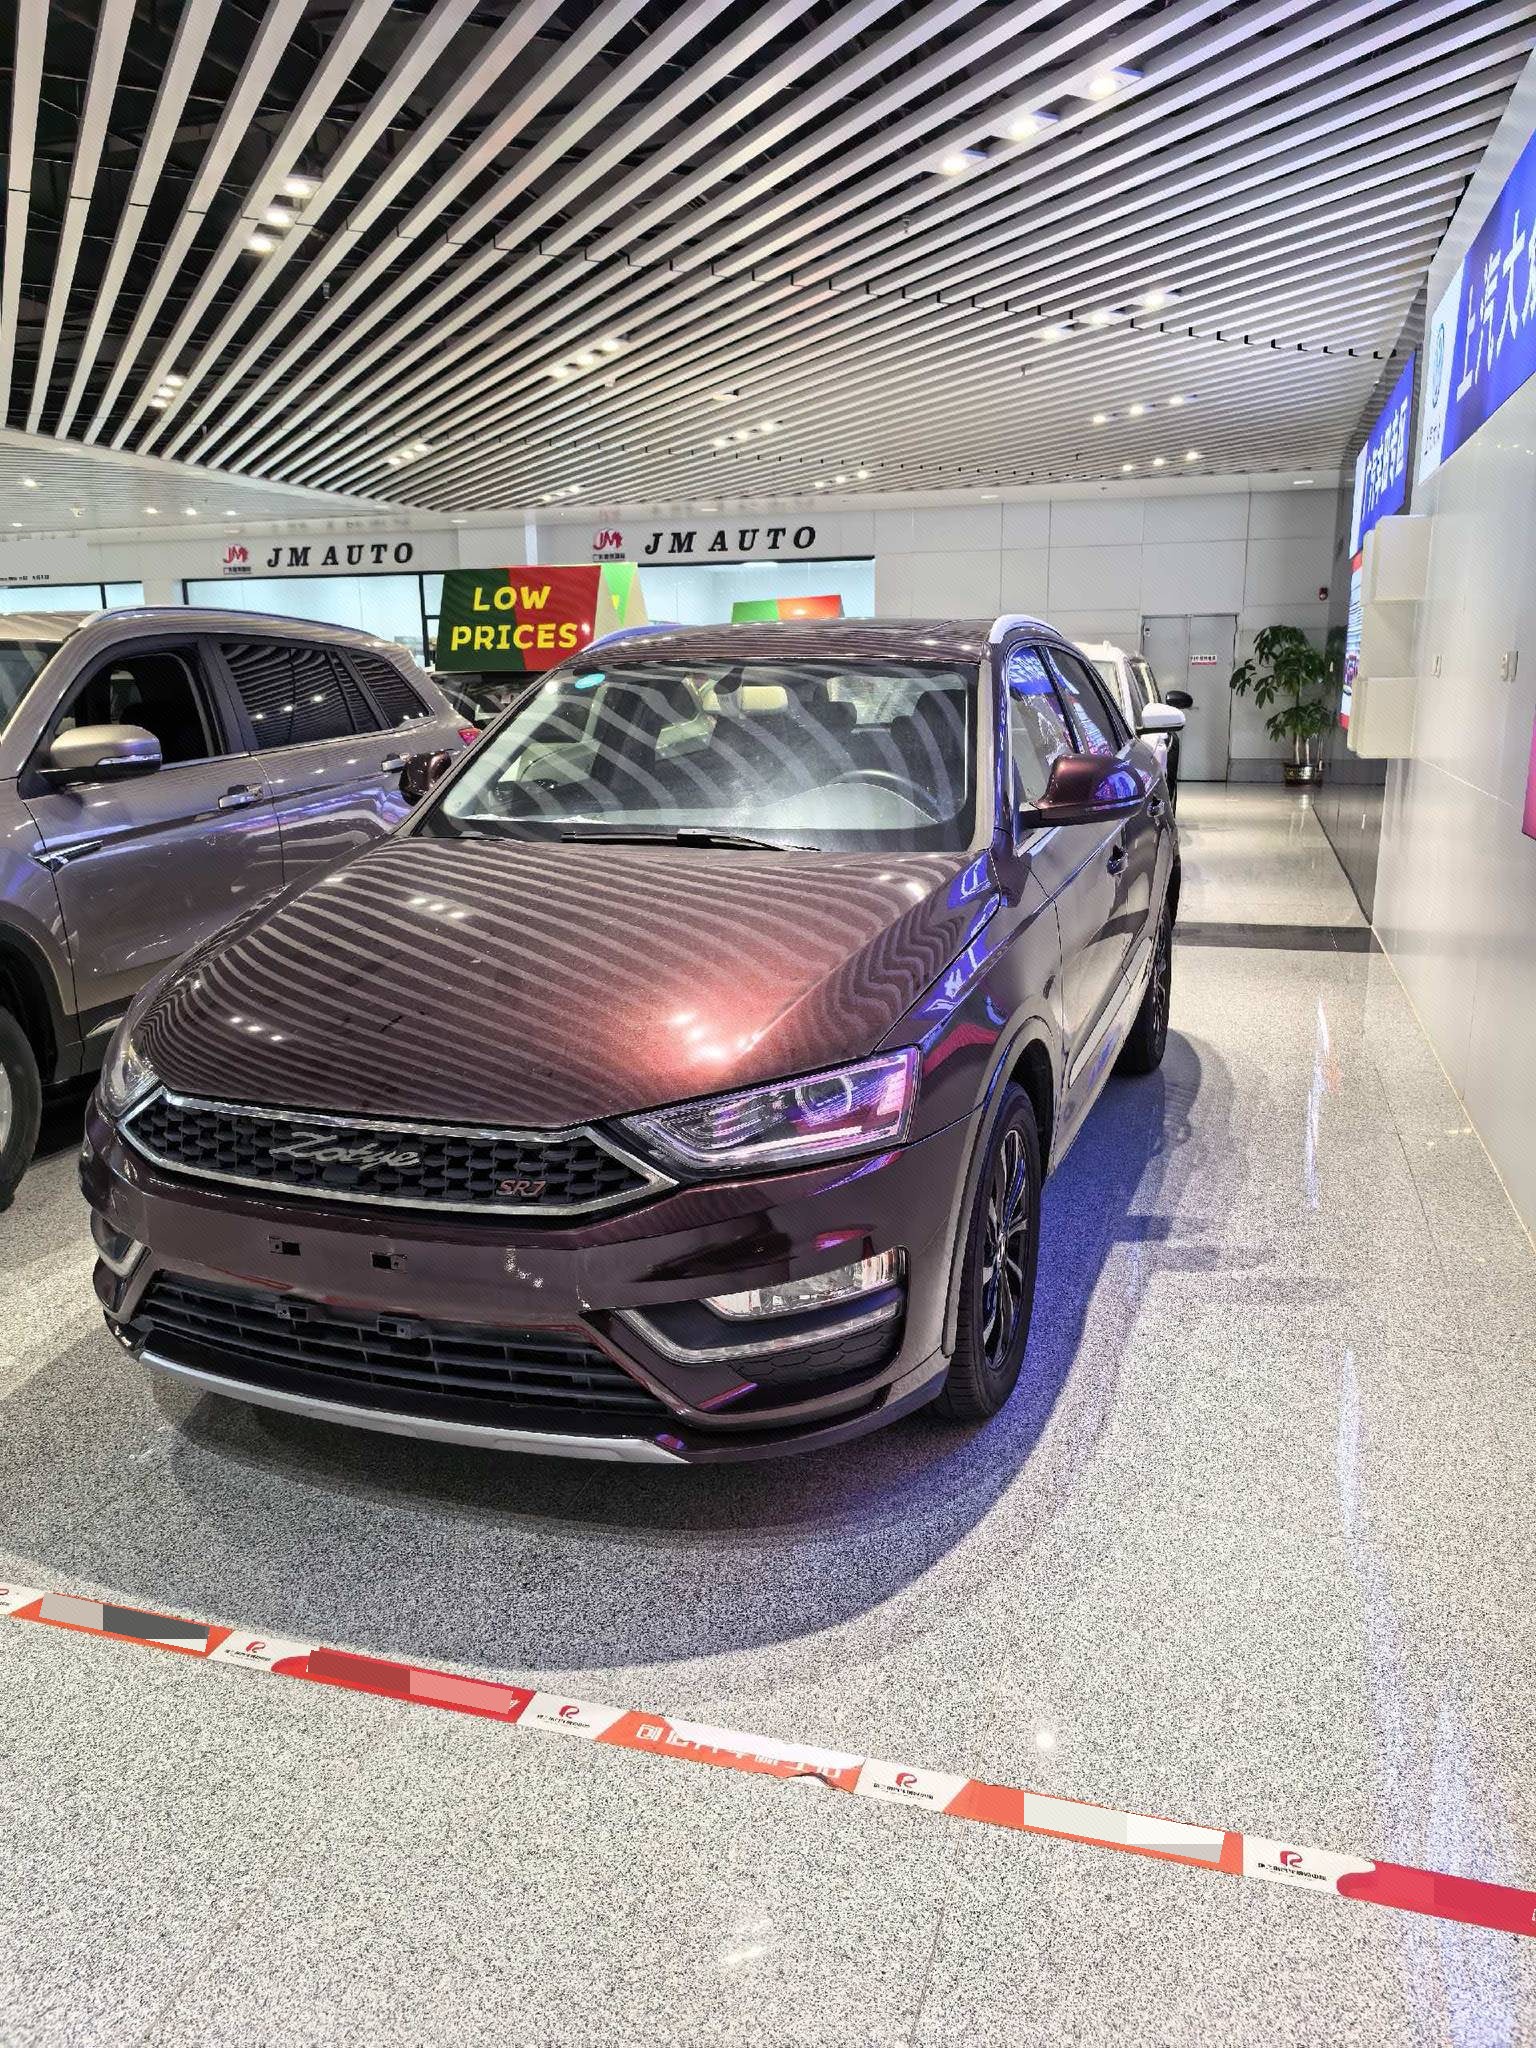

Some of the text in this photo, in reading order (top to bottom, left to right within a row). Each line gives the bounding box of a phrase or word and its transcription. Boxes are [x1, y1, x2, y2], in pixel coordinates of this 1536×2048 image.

[593, 530, 623, 550] JM
[645, 526, 816, 555] JM AUTO
[223, 544, 249, 564] JM
[267, 542, 414, 568] JM AUTO
[473, 585, 551, 611] LOW
[451, 622, 578, 651] PRICES
[269, 1131, 421, 1171] Zotye
